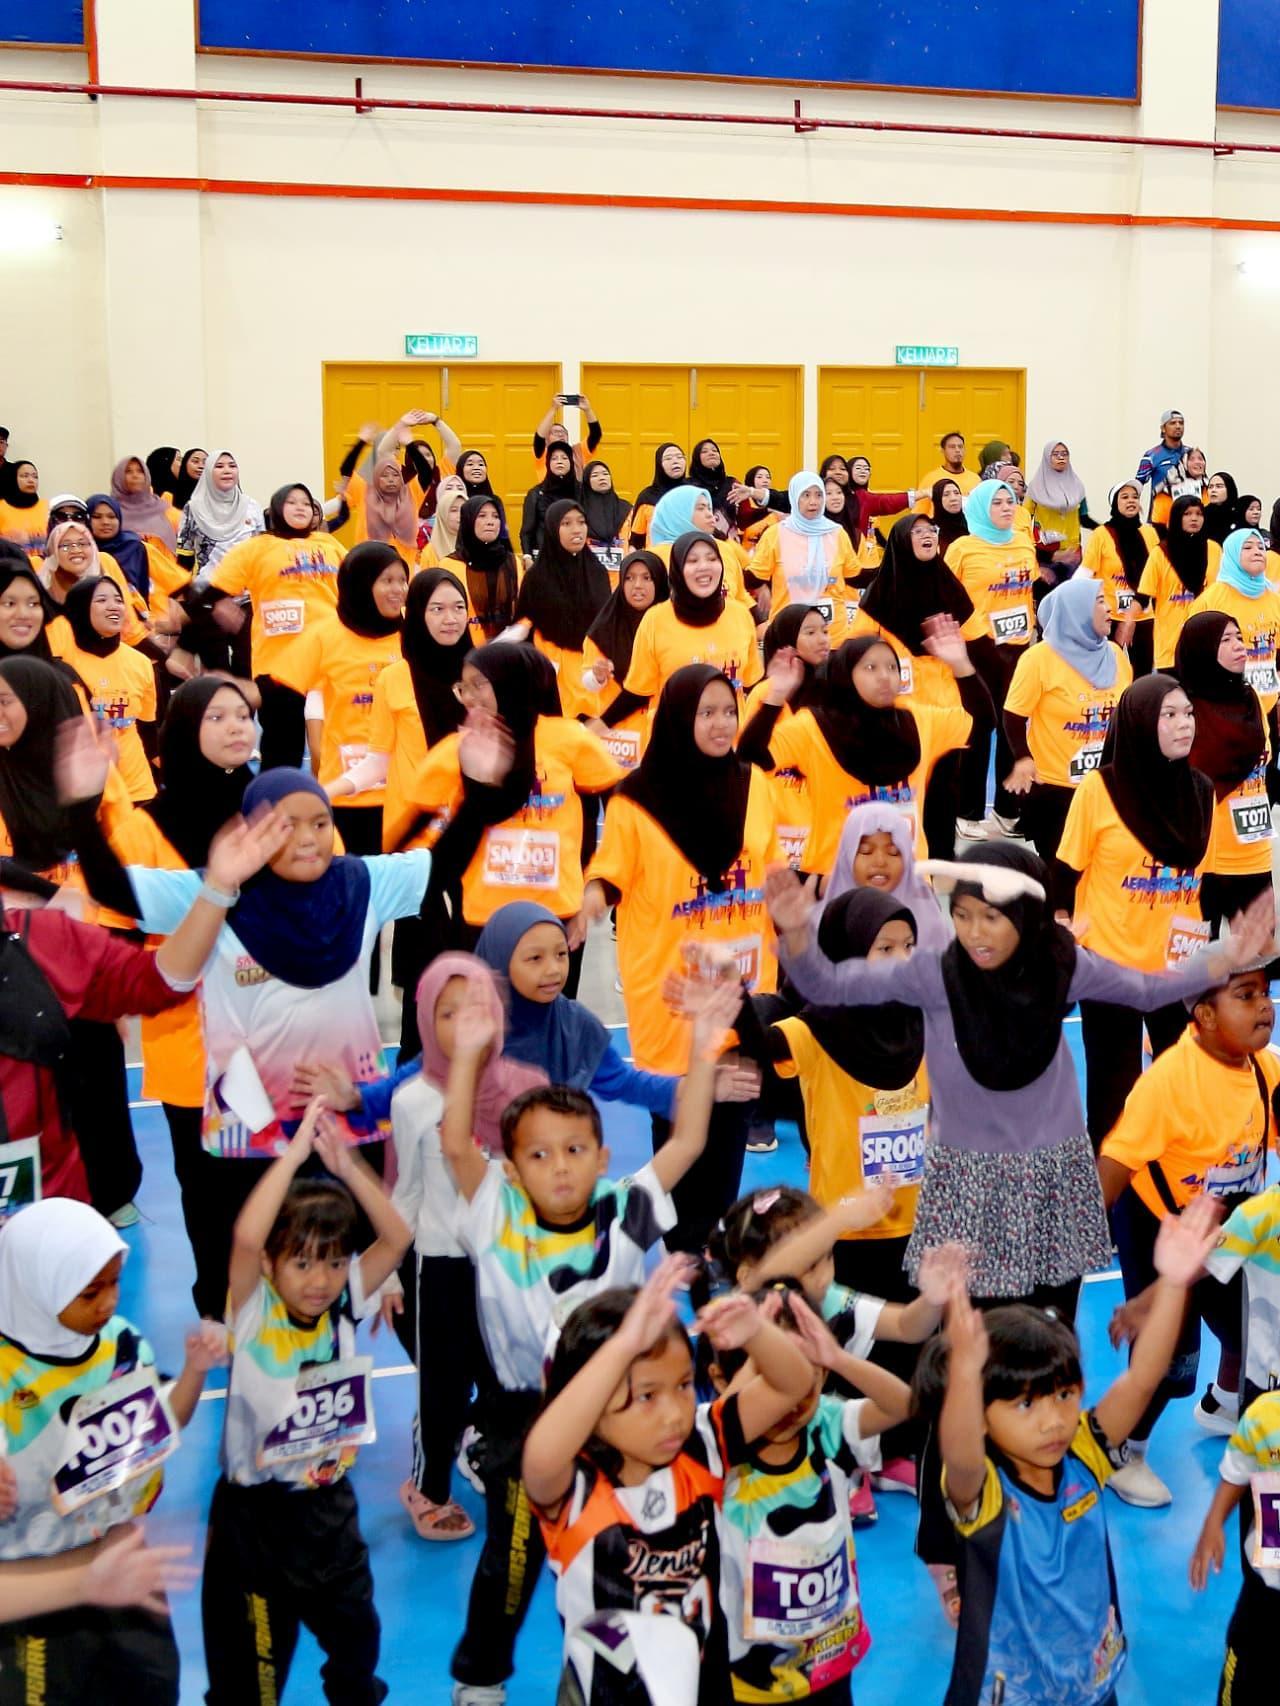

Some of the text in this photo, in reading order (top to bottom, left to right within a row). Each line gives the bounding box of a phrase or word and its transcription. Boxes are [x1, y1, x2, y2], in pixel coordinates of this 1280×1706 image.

[1079, 751, 1102, 771] T07
[279, 1385, 355, 1432] 036
[67, 1400, 156, 1470] 002
